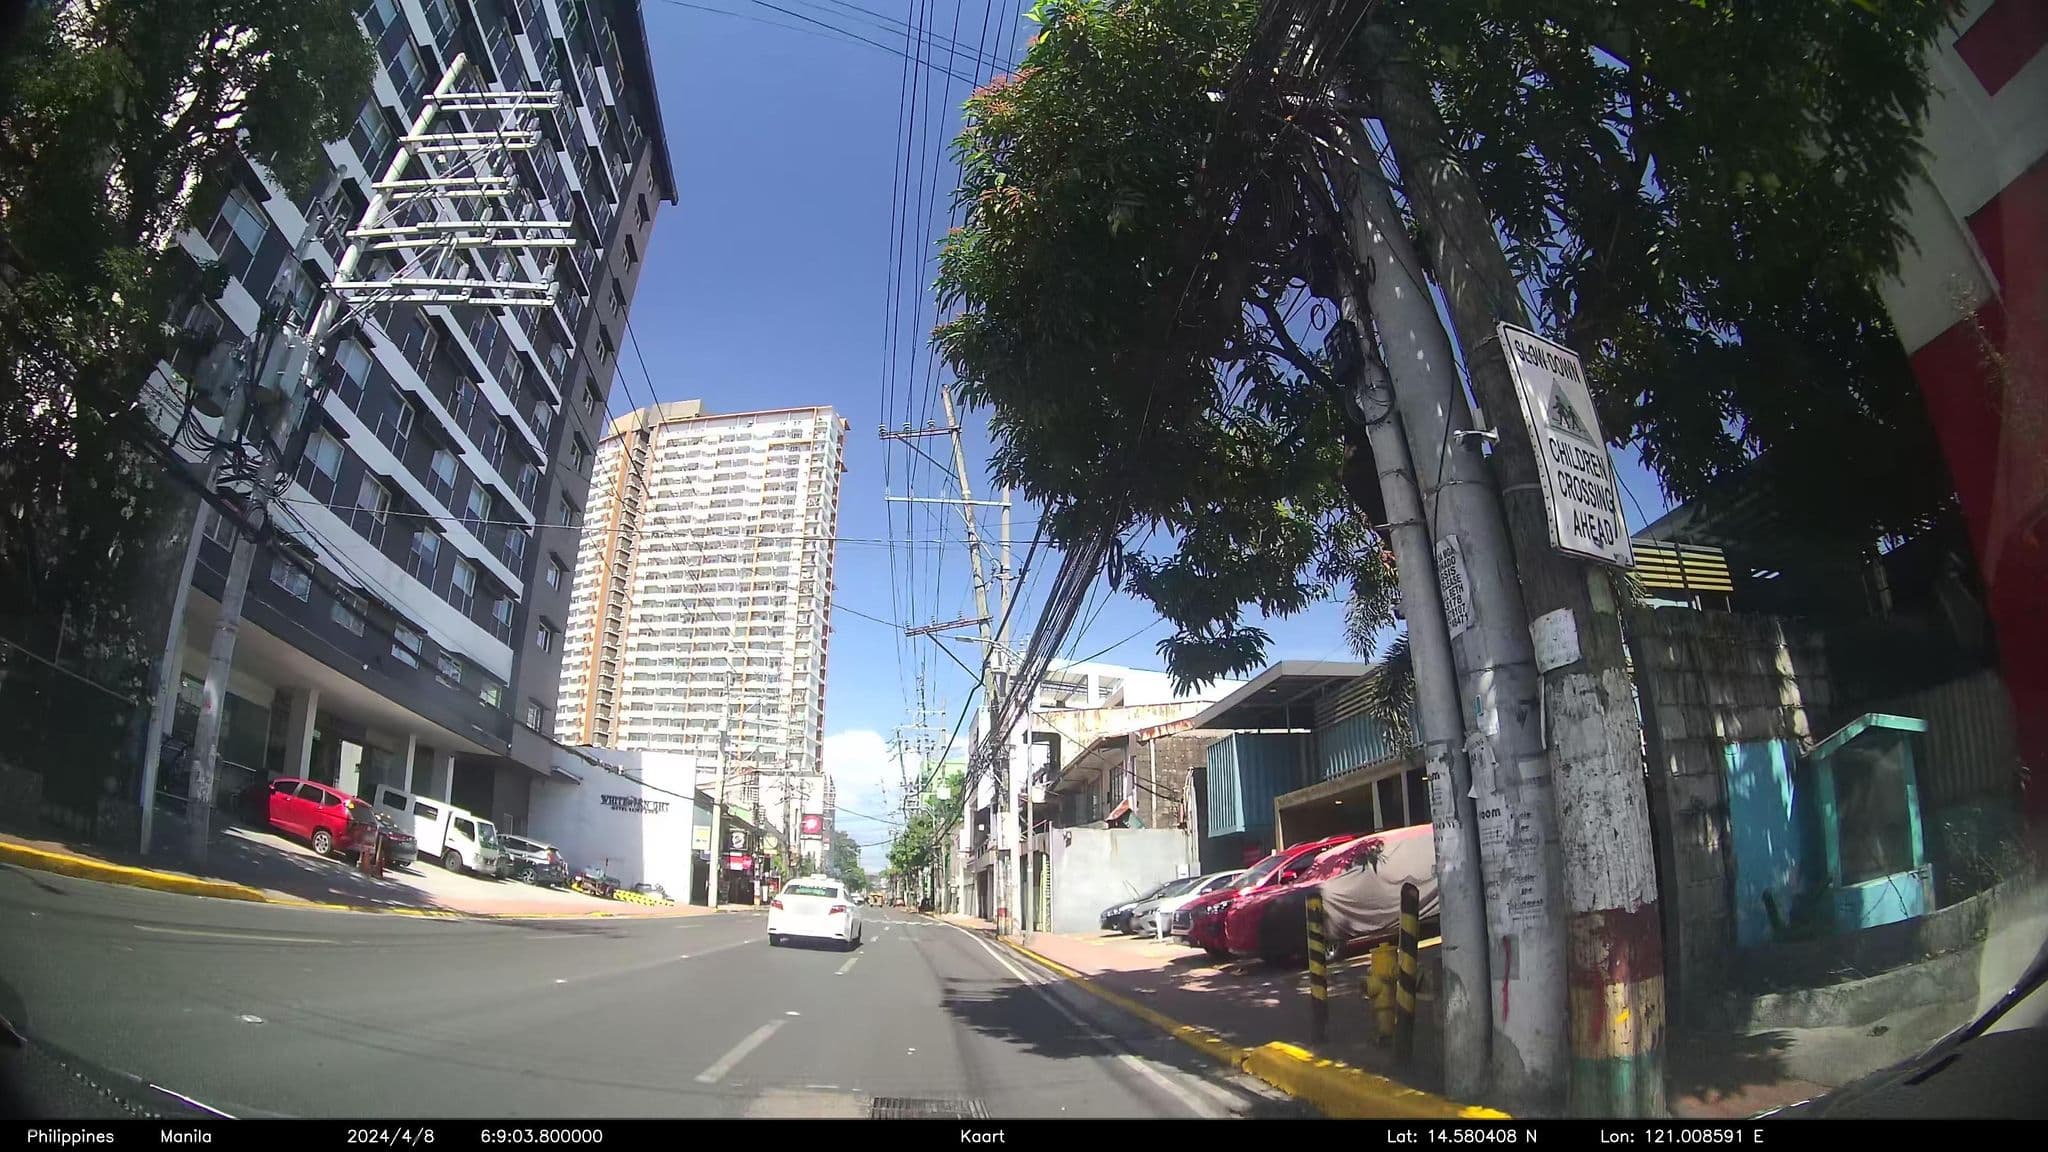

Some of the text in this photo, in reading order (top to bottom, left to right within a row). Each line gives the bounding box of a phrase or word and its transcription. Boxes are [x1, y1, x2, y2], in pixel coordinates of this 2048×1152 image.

[1515, 340, 1581, 384] SLOW DOWN
[1549, 437, 1608, 481] CHILDREN
[1557, 470, 1616, 513] CROSSING
[1574, 508, 1614, 545] AHEAD
